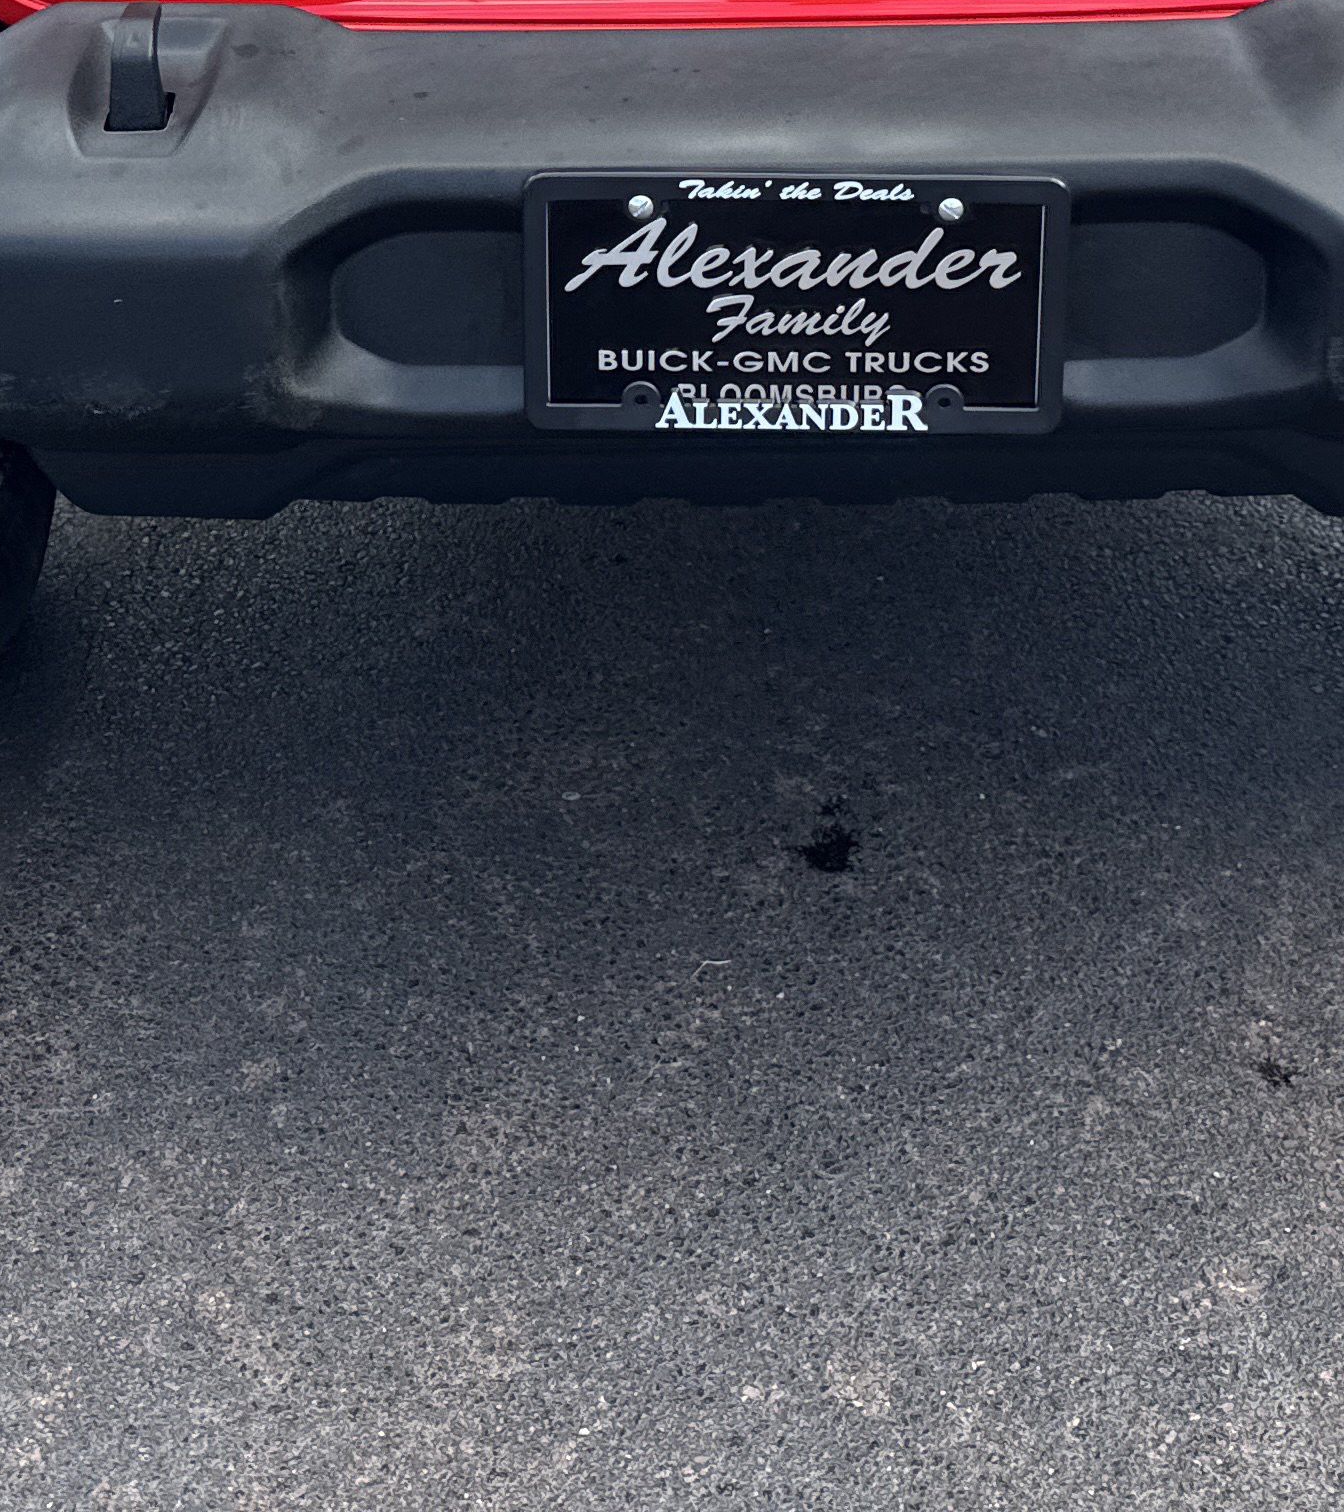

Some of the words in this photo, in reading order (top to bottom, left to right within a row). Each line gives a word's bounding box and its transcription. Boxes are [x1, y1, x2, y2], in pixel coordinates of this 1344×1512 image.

[678, 179, 773, 200] Takin'
[779, 181, 822, 201] the
[833, 180, 915, 201] Deals
[564, 217, 1022, 293] Alexander
[705, 294, 892, 347] Family
[598, 349, 832, 374] BUICK-GMC
[847, 350, 990, 374] TRUCKS
[678, 382, 908, 406] BLOOMSBUR
[655, 390, 929, 432] ALEXANDER
